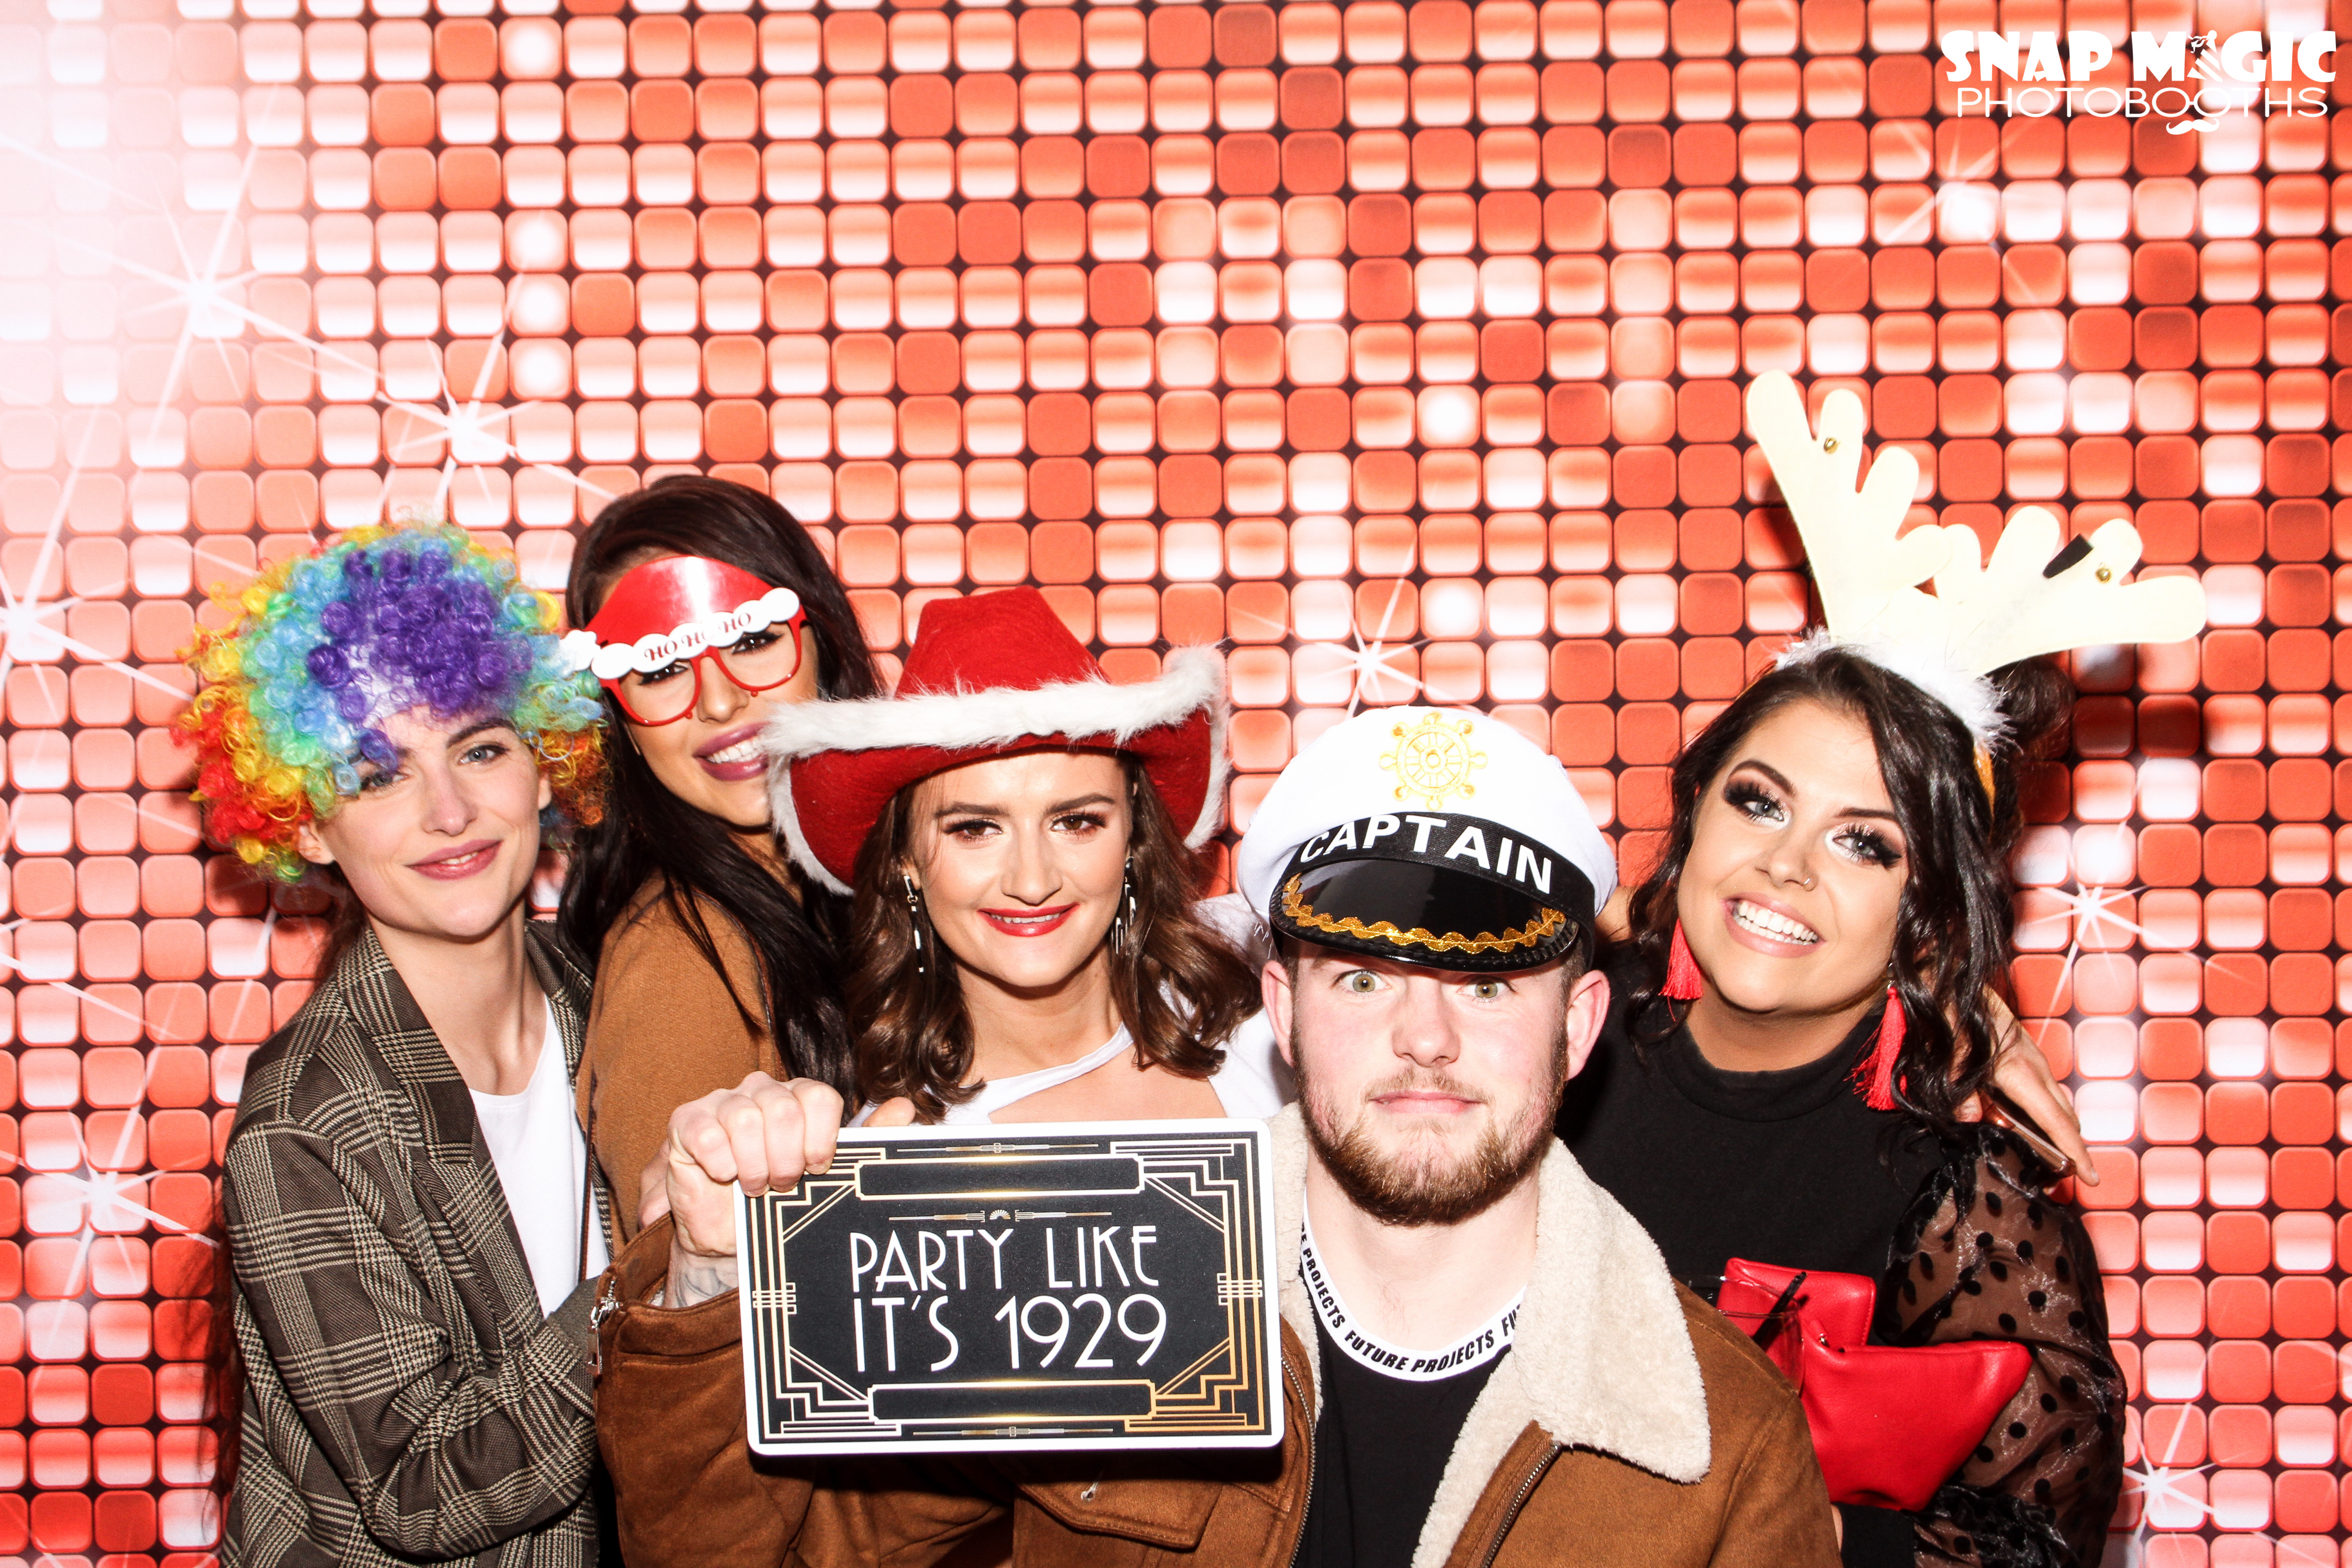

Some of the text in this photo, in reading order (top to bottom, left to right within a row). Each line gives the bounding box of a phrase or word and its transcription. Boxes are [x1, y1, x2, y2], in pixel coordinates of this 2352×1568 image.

[644, 640, 678, 661] HO
[718, 612, 751, 633] HO
[1299, 814, 1552, 894] CAPTAIN
[850, 1225, 1159, 1293] PARTY LIKE
[853, 1293, 1167, 1372] IT'S 1929
[1303, 1248, 1346, 1328] PROJECTS
[1344, 1330, 1409, 1371] FUTURE
[1410, 1329, 1494, 1372] PROJECTS
